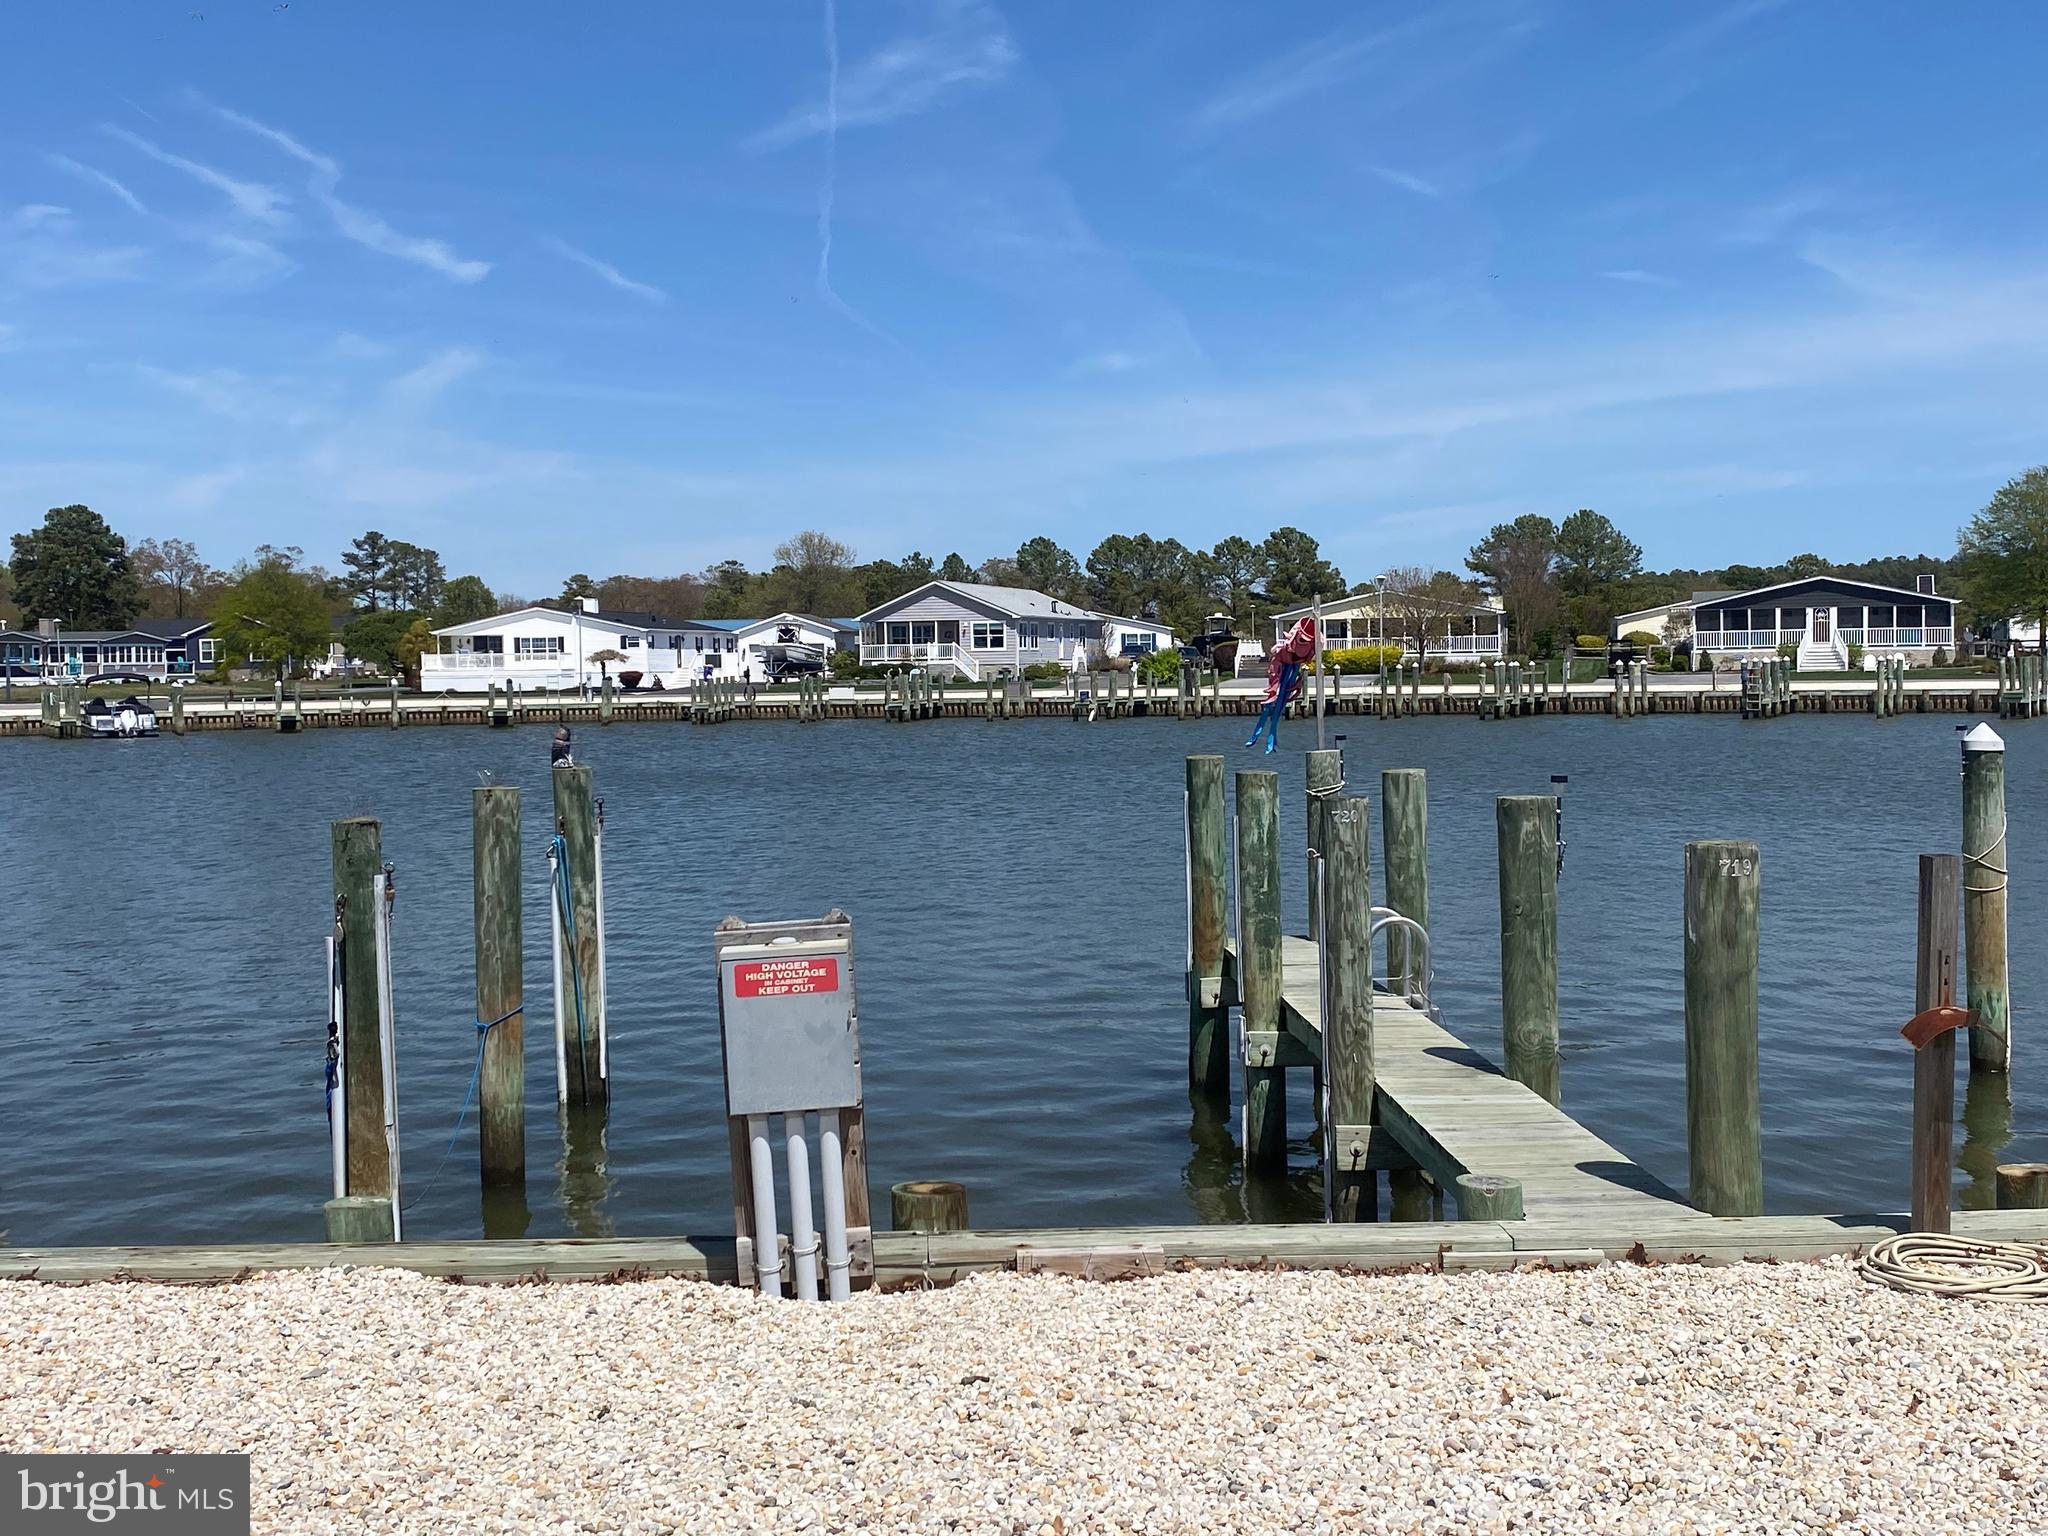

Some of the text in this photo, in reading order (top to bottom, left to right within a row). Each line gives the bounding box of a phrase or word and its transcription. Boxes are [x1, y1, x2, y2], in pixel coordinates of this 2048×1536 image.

[1718, 858, 1752, 877] 719
[761, 961, 810, 972] DANGER
[745, 968, 826, 981] HIGH VOLTAGE
[774, 978, 809, 986] CABINET
[758, 984, 816, 995] KEEP OUT
